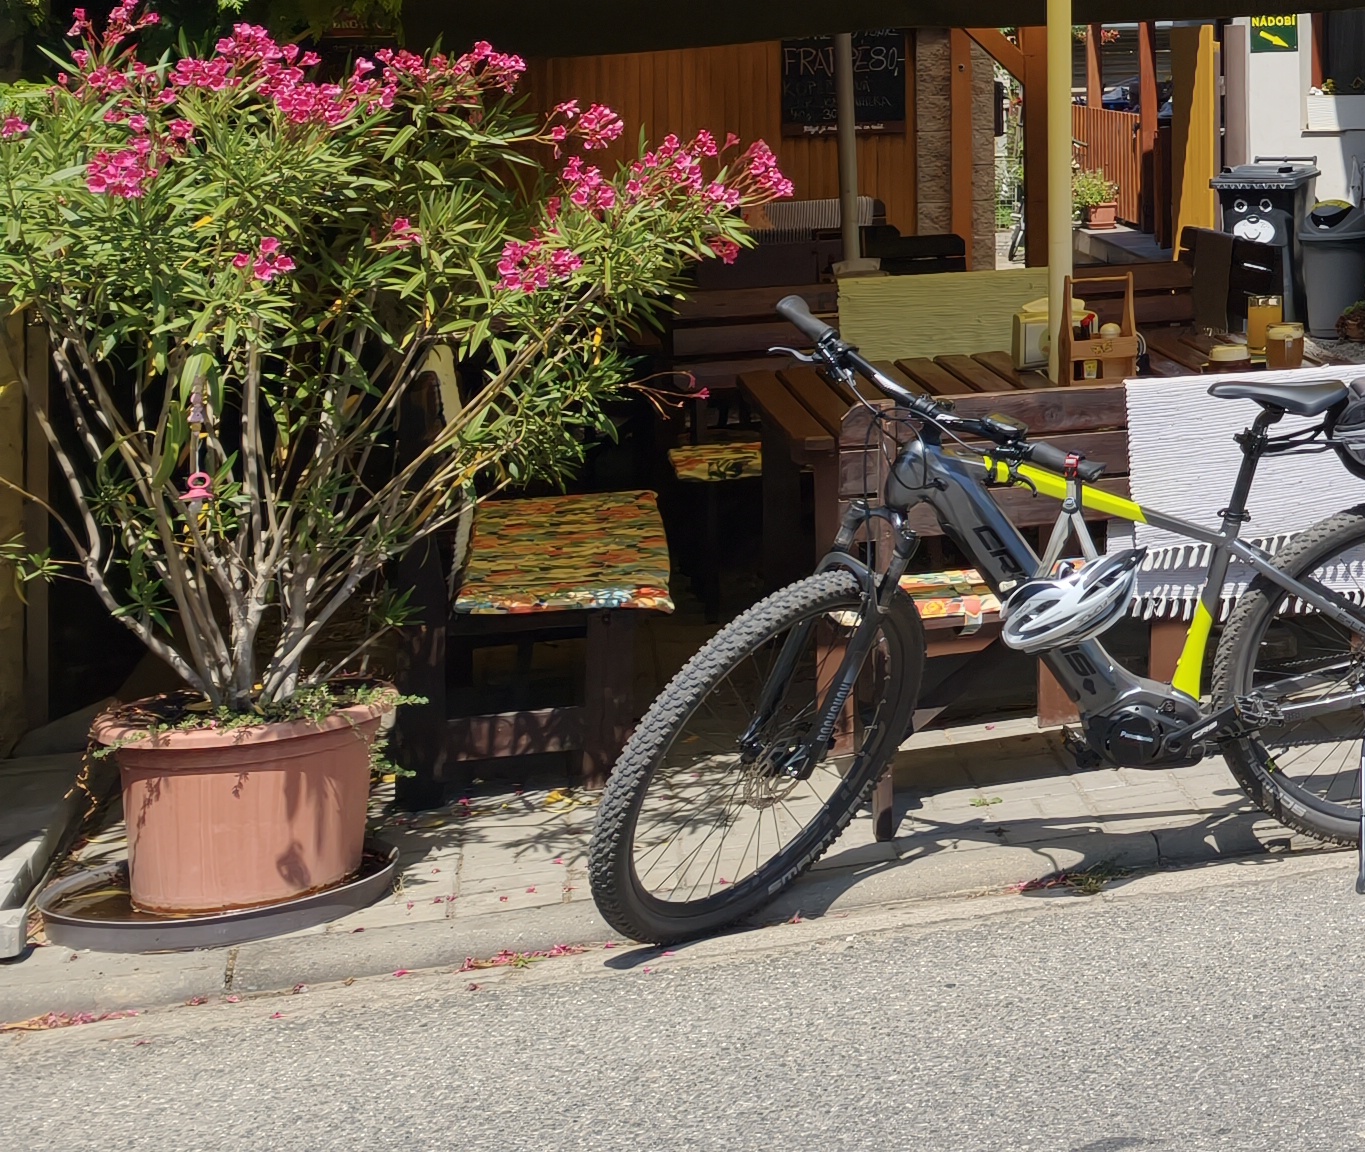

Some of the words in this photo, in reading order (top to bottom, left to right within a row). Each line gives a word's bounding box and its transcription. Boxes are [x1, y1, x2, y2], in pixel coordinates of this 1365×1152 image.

[1251, 14, 1297, 28] NÁDOBÍ
[783, 39, 871, 77] FRAÉ
[1239, 737, 1307, 817] SCHWALB
[768, 829, 835, 895] SMART
